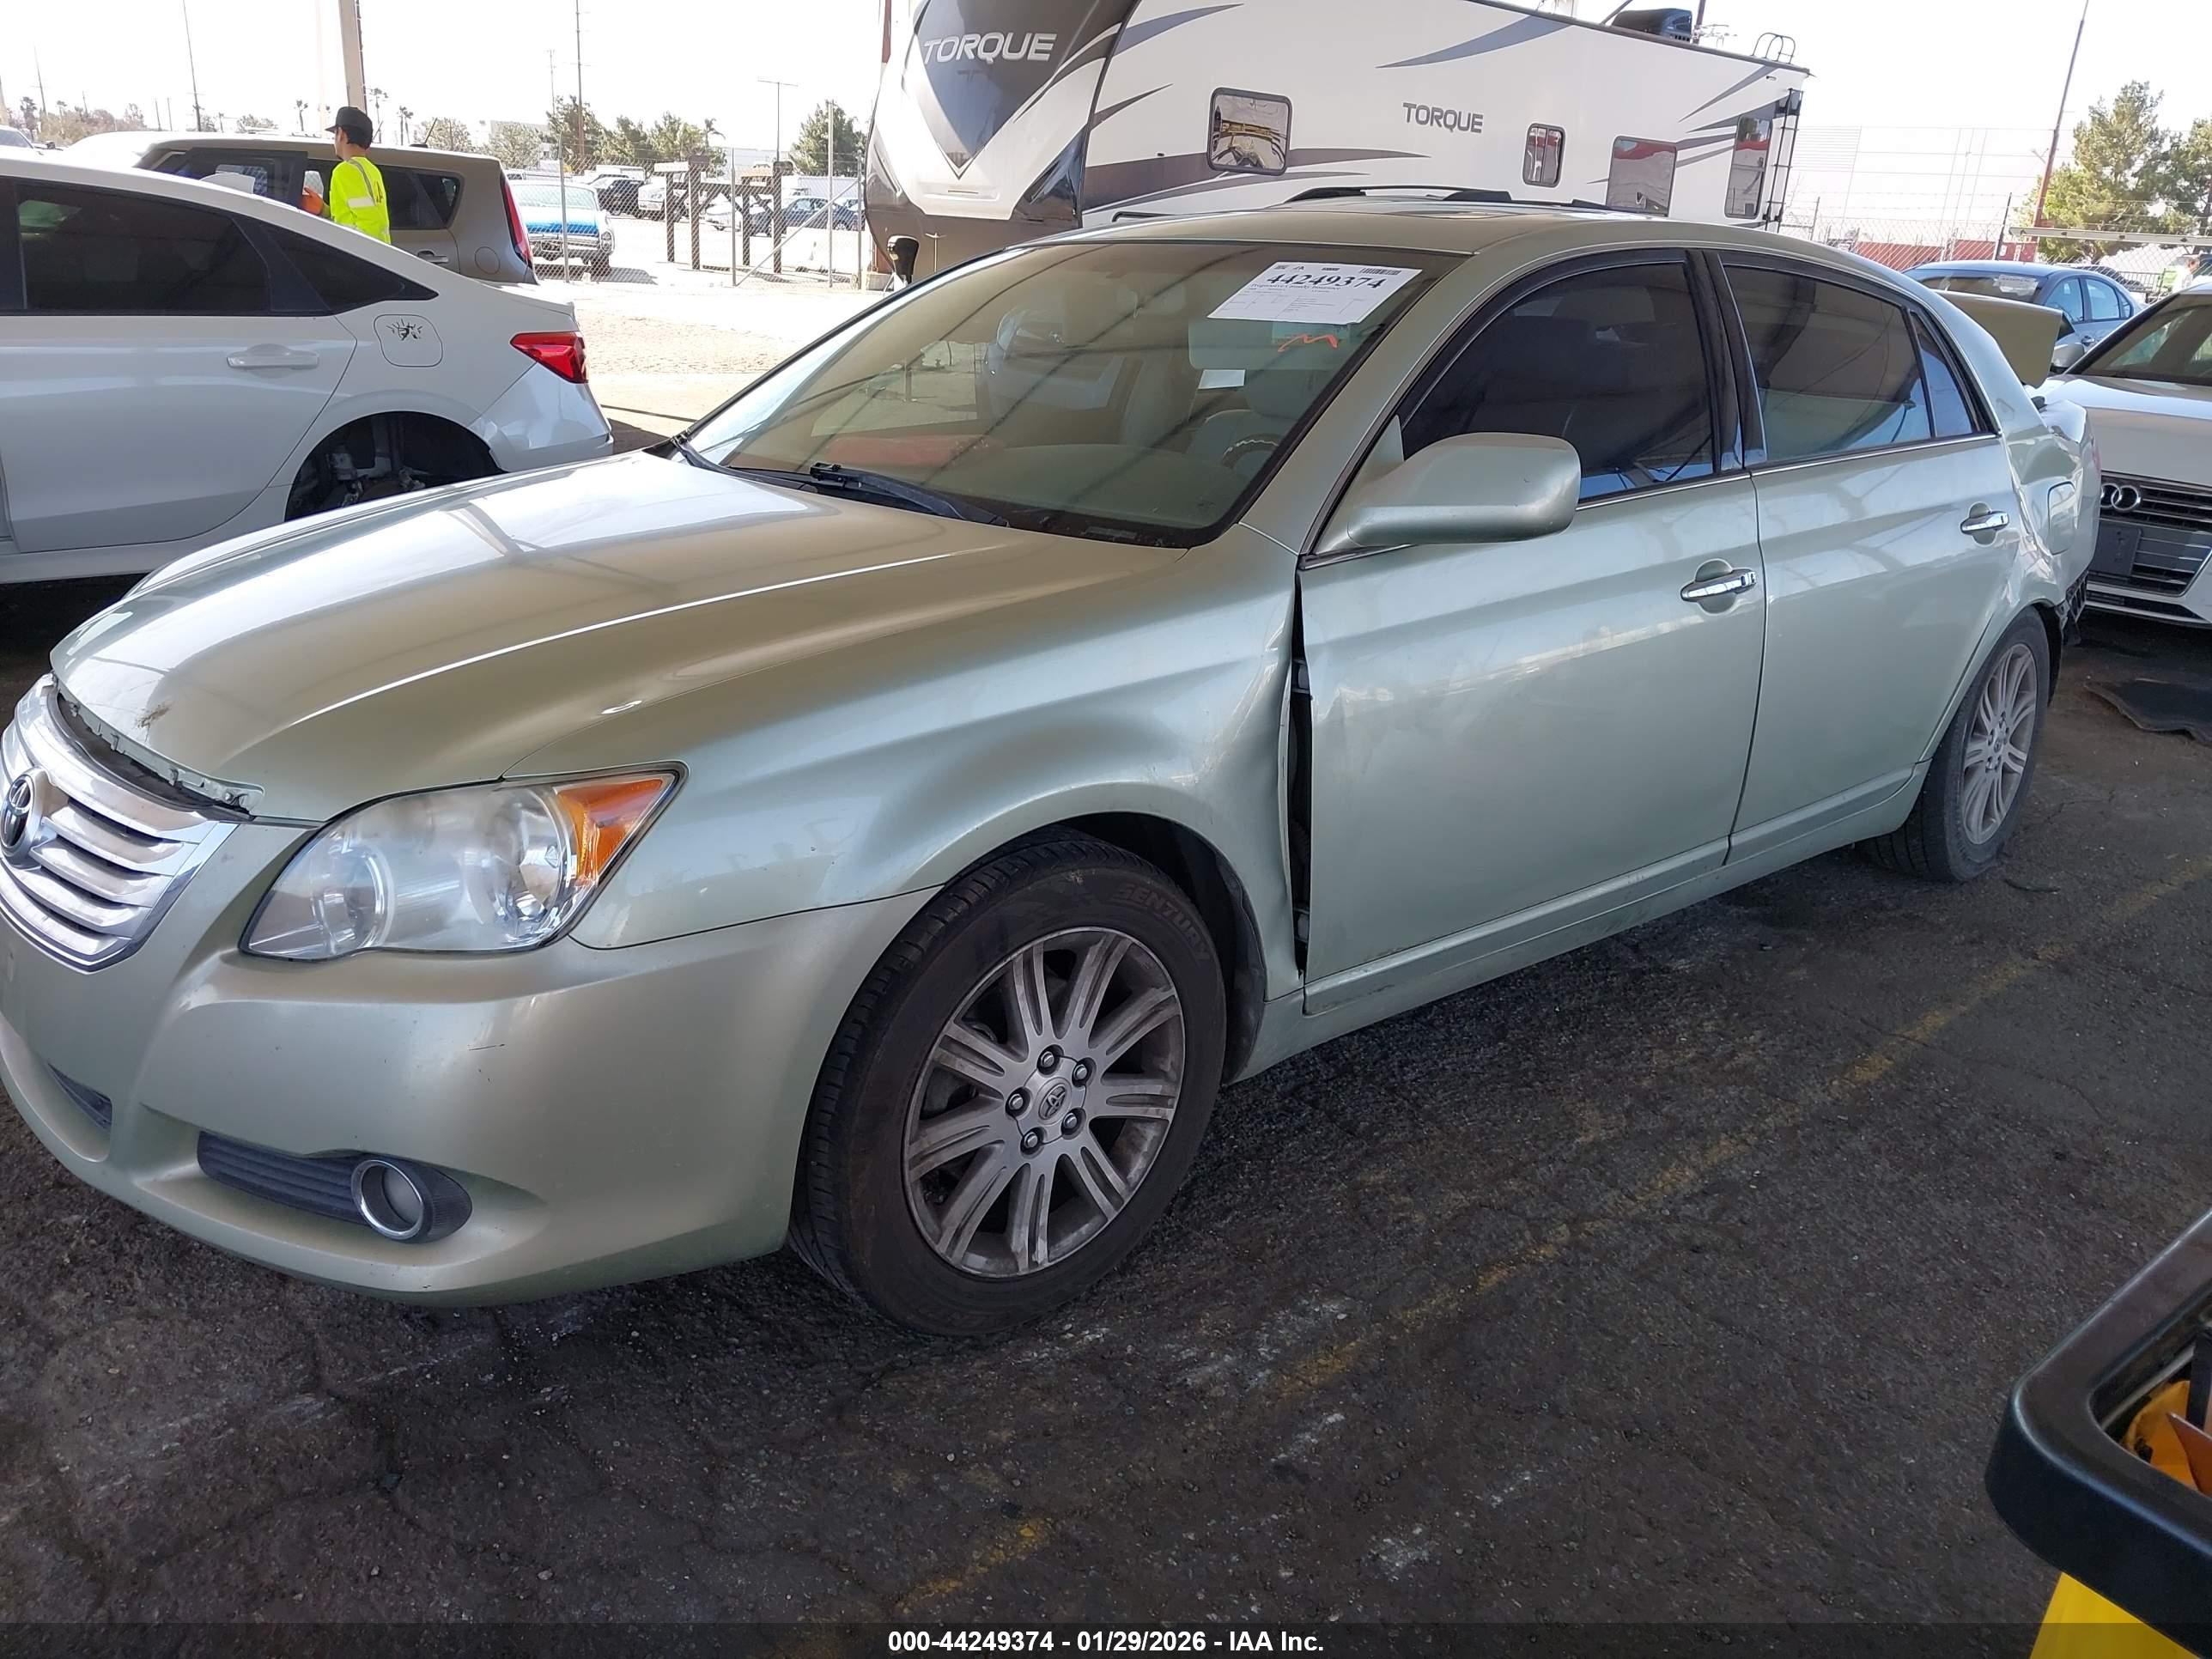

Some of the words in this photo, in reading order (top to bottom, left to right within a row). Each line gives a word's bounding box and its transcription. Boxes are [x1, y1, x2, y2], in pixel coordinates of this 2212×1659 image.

[923, 32, 1057, 64] TORQUE
[1403, 102, 1484, 133] TORQUE
[1267, 273, 1387, 289] 44249374
